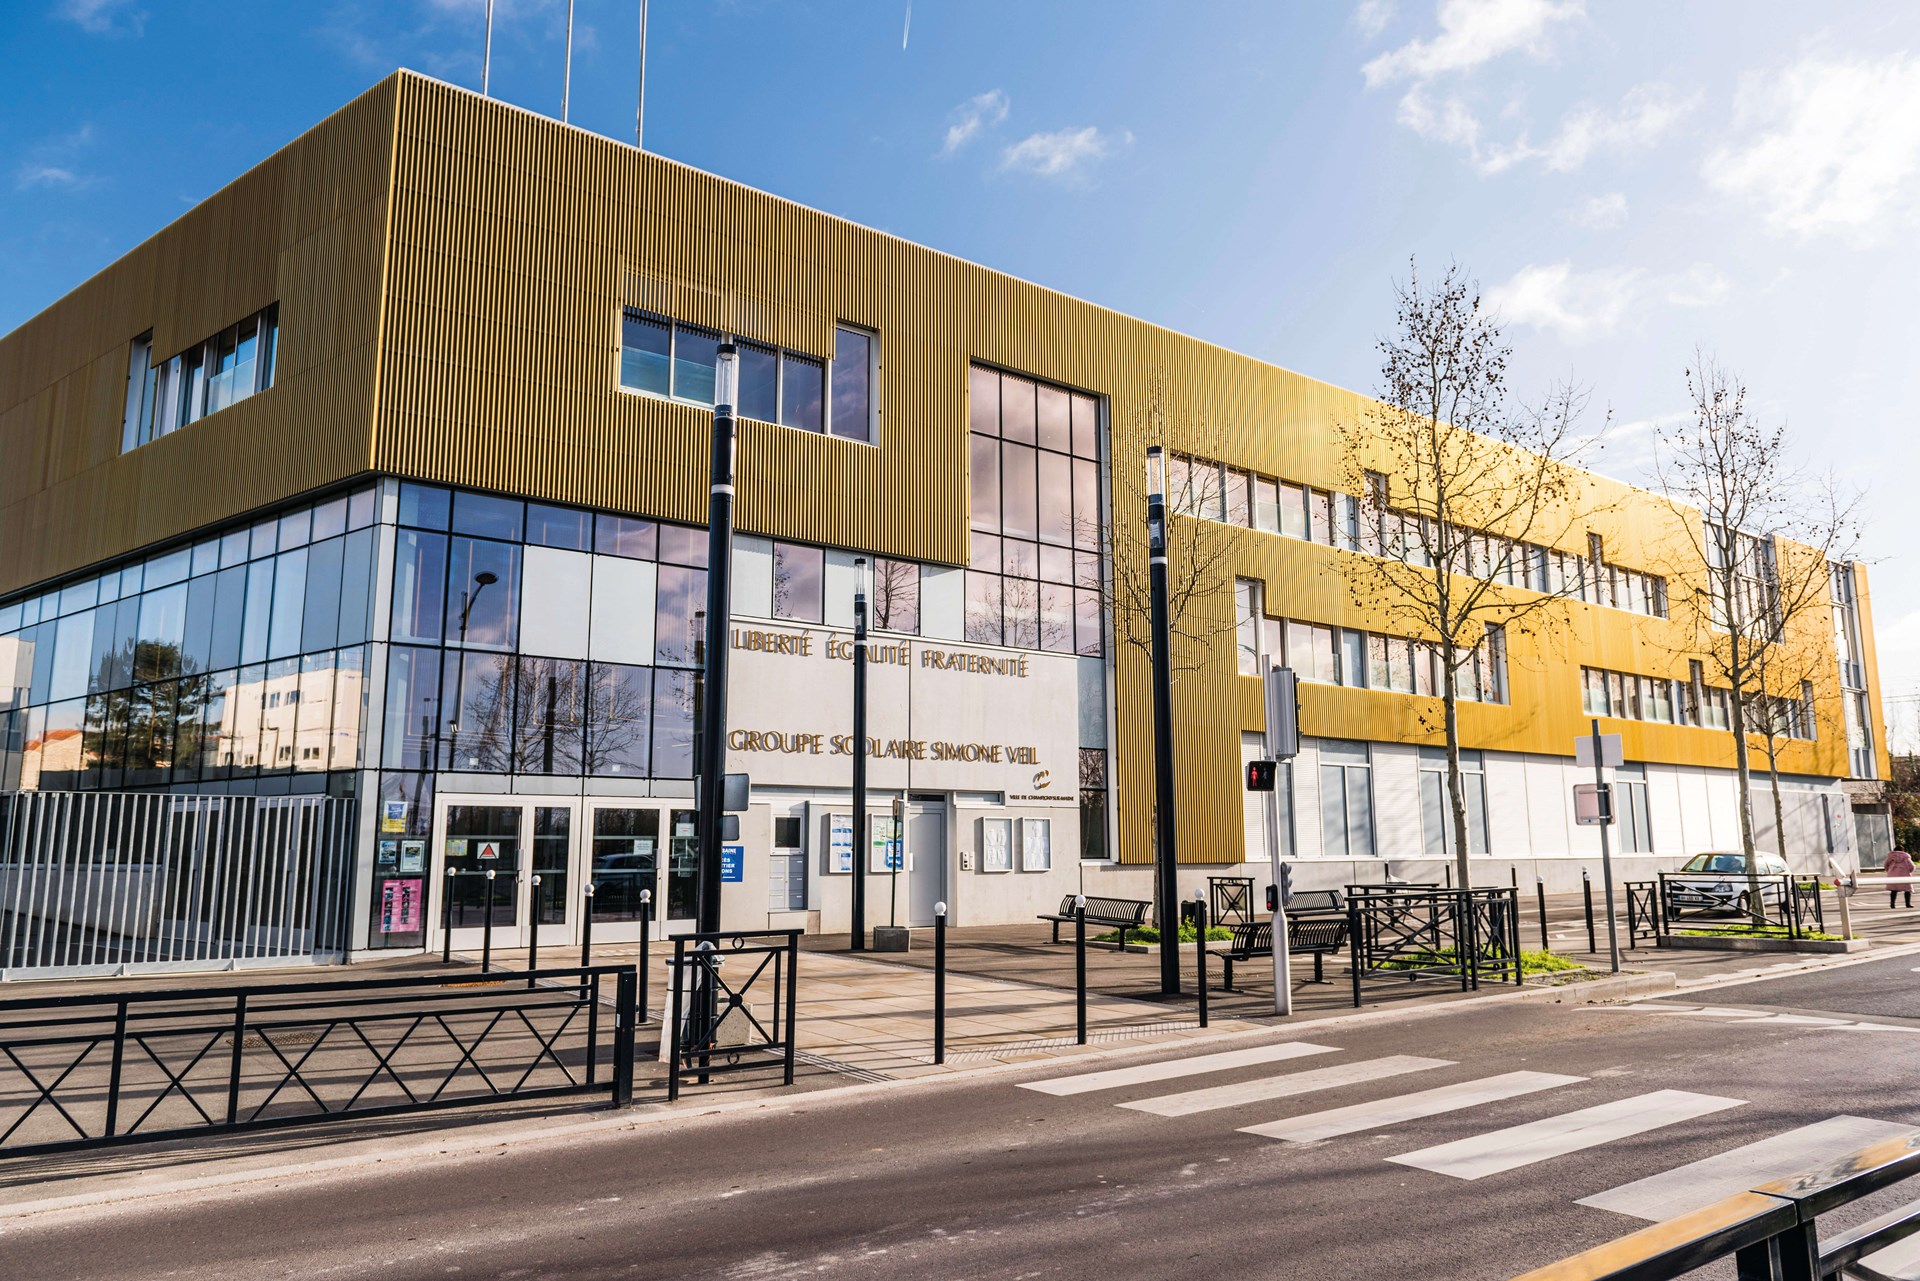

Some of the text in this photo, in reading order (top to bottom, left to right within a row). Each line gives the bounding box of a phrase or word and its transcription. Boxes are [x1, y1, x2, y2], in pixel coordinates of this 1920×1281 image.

[733, 628, 813, 656] LIBERTÉ
[924, 649, 1030, 677] FRATERNITÉ
[729, 729, 824, 754] GROUPE
[933, 741, 1003, 763] SIMONE
[1007, 745, 1041, 764] VEIL
